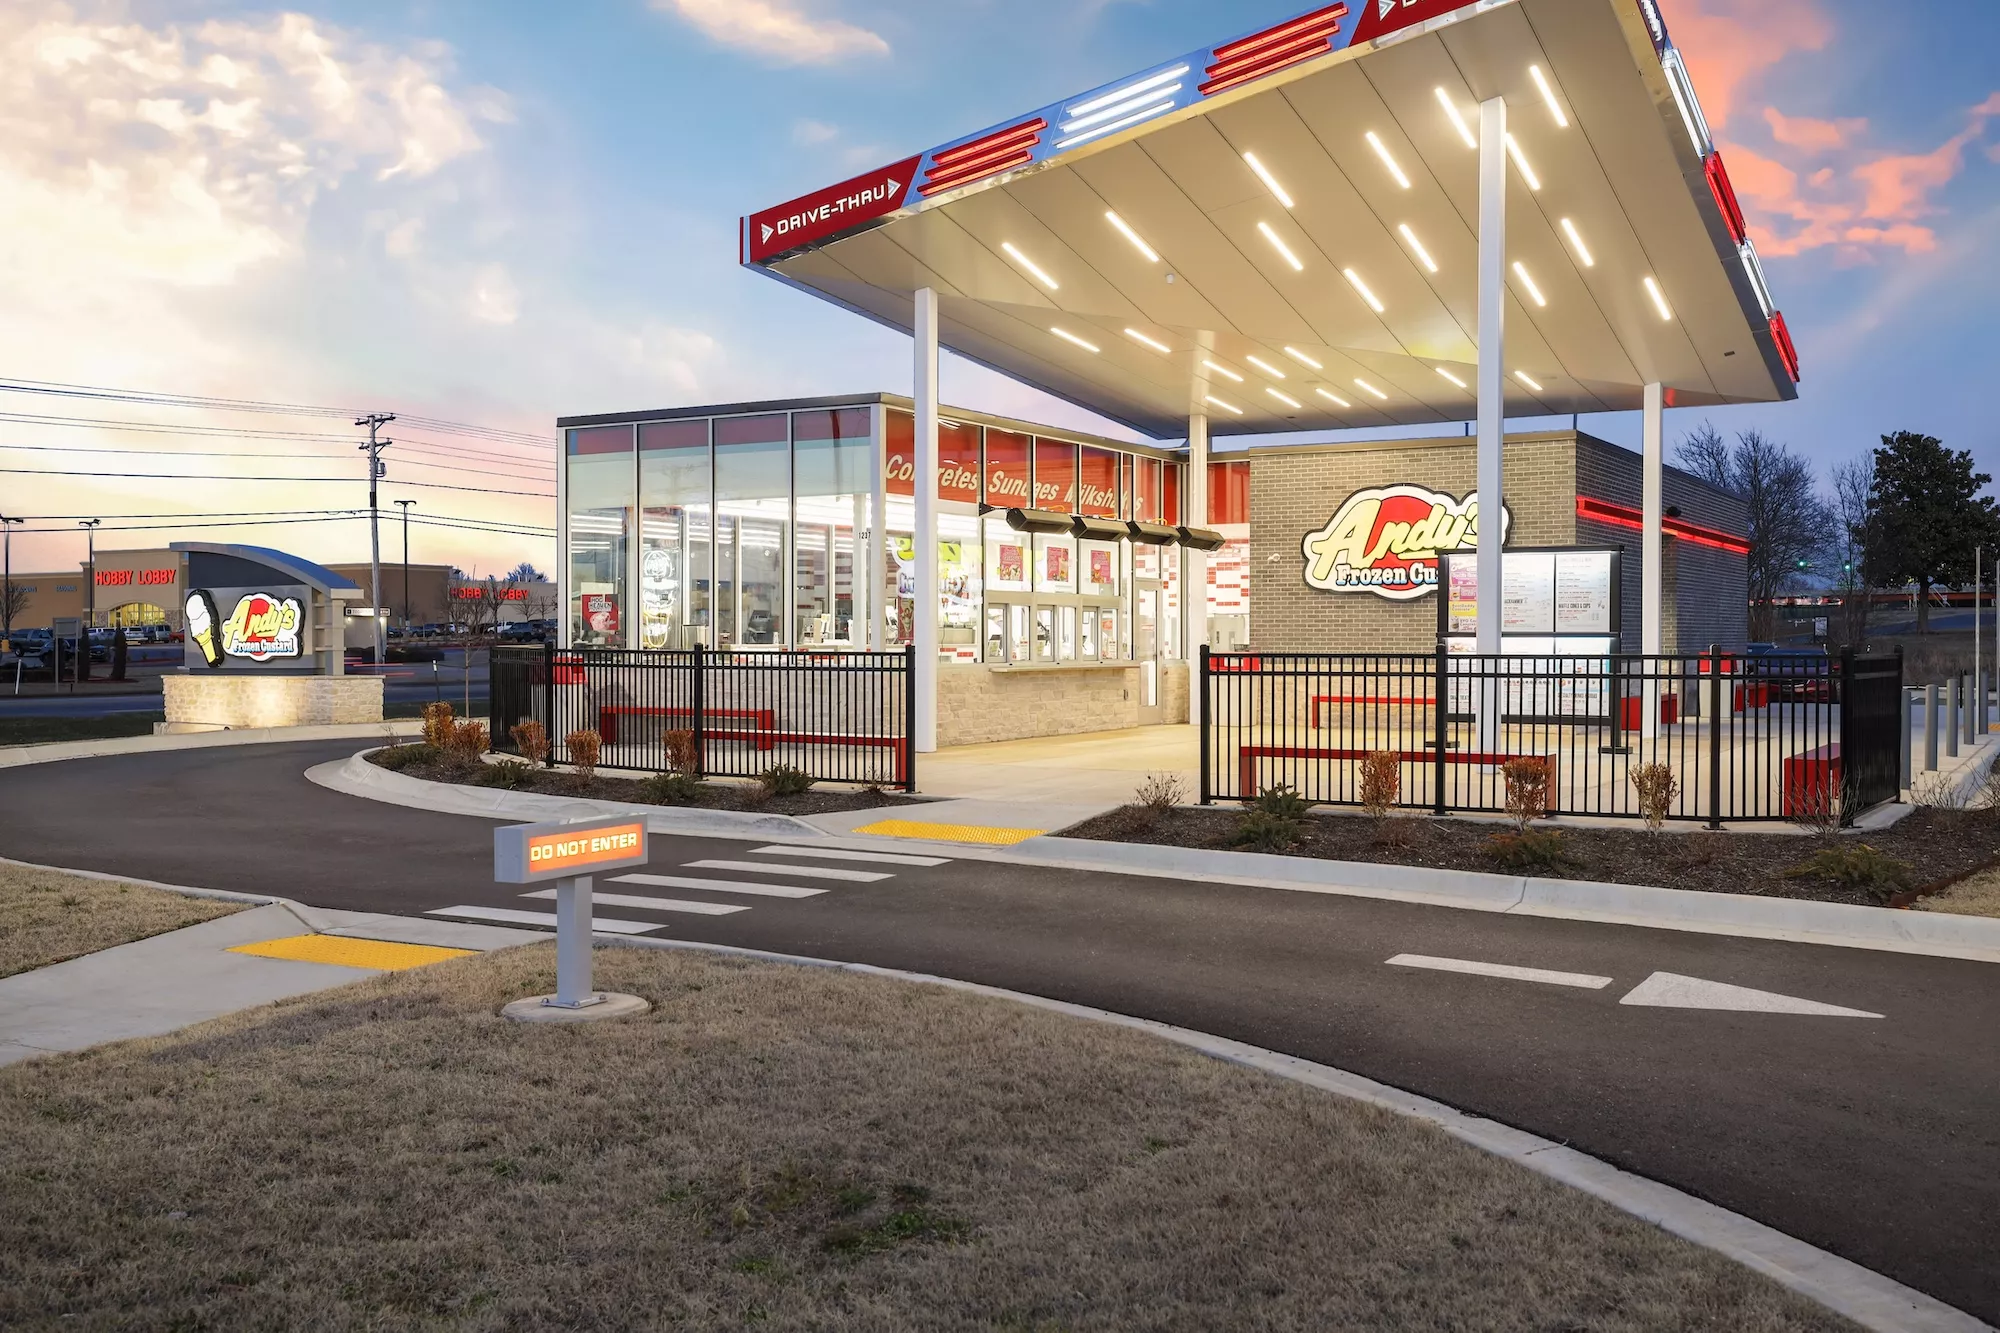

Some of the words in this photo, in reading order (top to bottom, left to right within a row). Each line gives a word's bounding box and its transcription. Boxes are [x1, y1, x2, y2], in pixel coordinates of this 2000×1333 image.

[777, 184, 885, 236] DRIVE-THRU
[858, 531, 871, 539] 1237
[96, 570, 133, 585] HOBBY
[138, 569, 177, 585] LOBBY
[1335, 563, 1408, 586] Frozen
[223, 599, 296, 650] Andy's
[233, 638, 260, 653] Frozen
[261, 638, 294, 653] Custard
[531, 845, 553, 861] DO
[557, 839, 588, 857] NOT
[591, 832, 637, 853] ENTER
